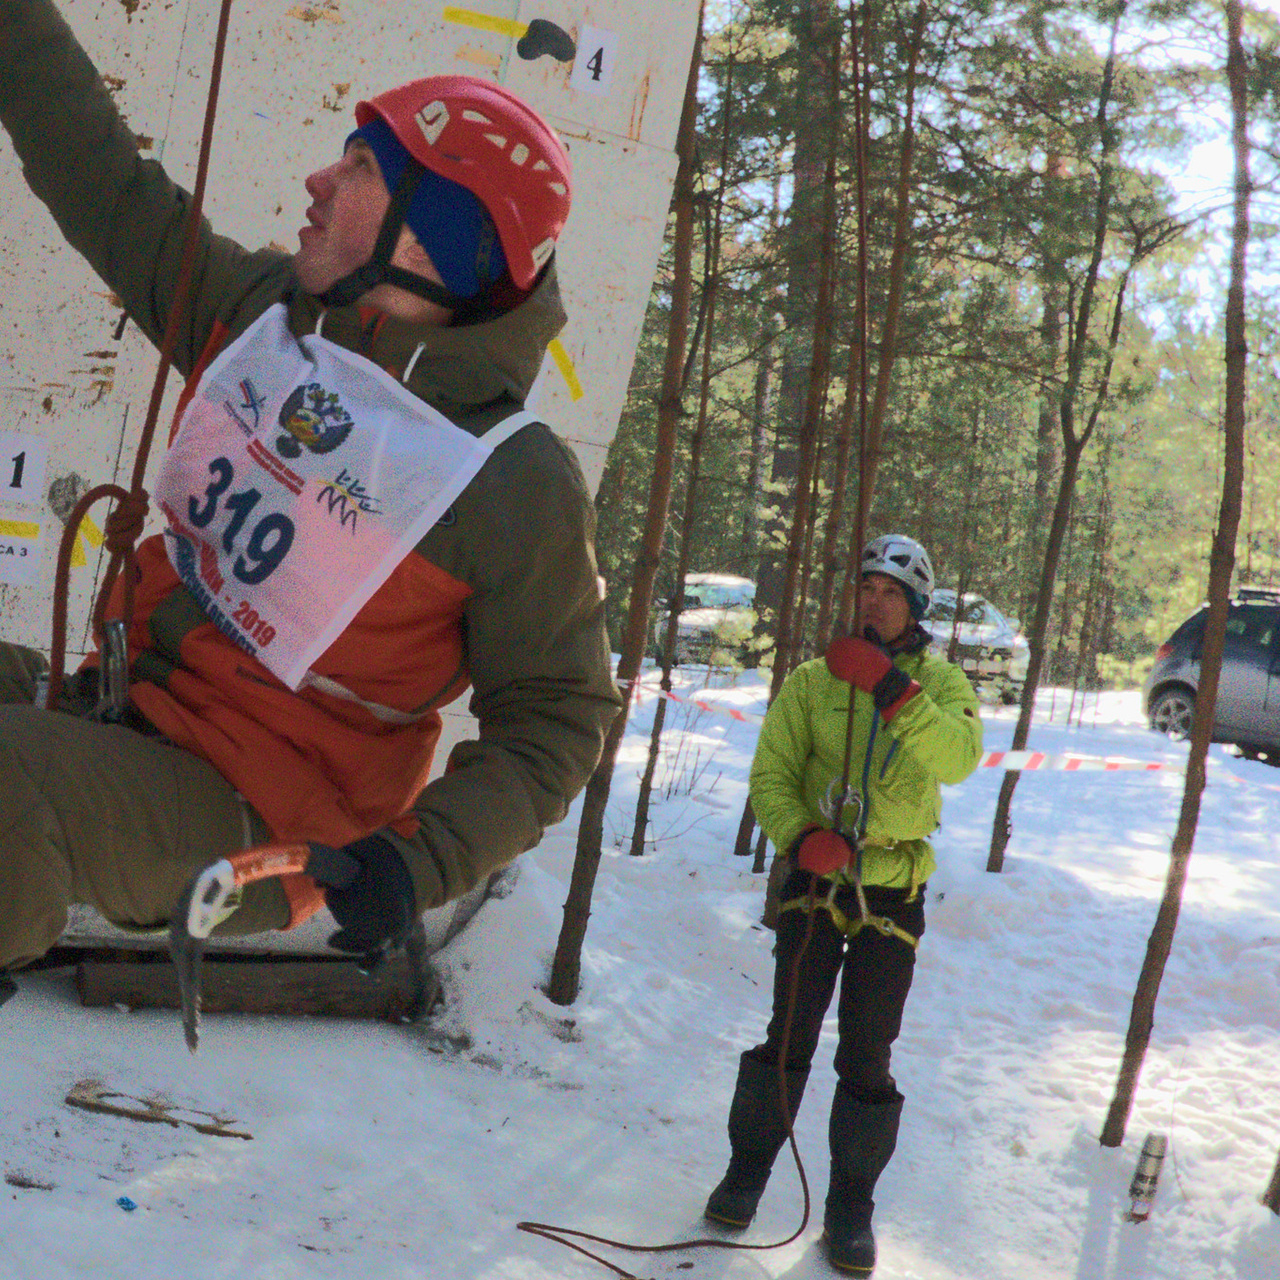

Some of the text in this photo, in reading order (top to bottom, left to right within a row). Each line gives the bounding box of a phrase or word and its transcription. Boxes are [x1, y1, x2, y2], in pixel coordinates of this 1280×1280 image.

[586, 47, 603, 81] 4
[9, 451, 25, 488] 1
[188, 457, 295, 585] 319
[19, 547, 28, 557] 3
[232, 601, 276, 648] 2019
